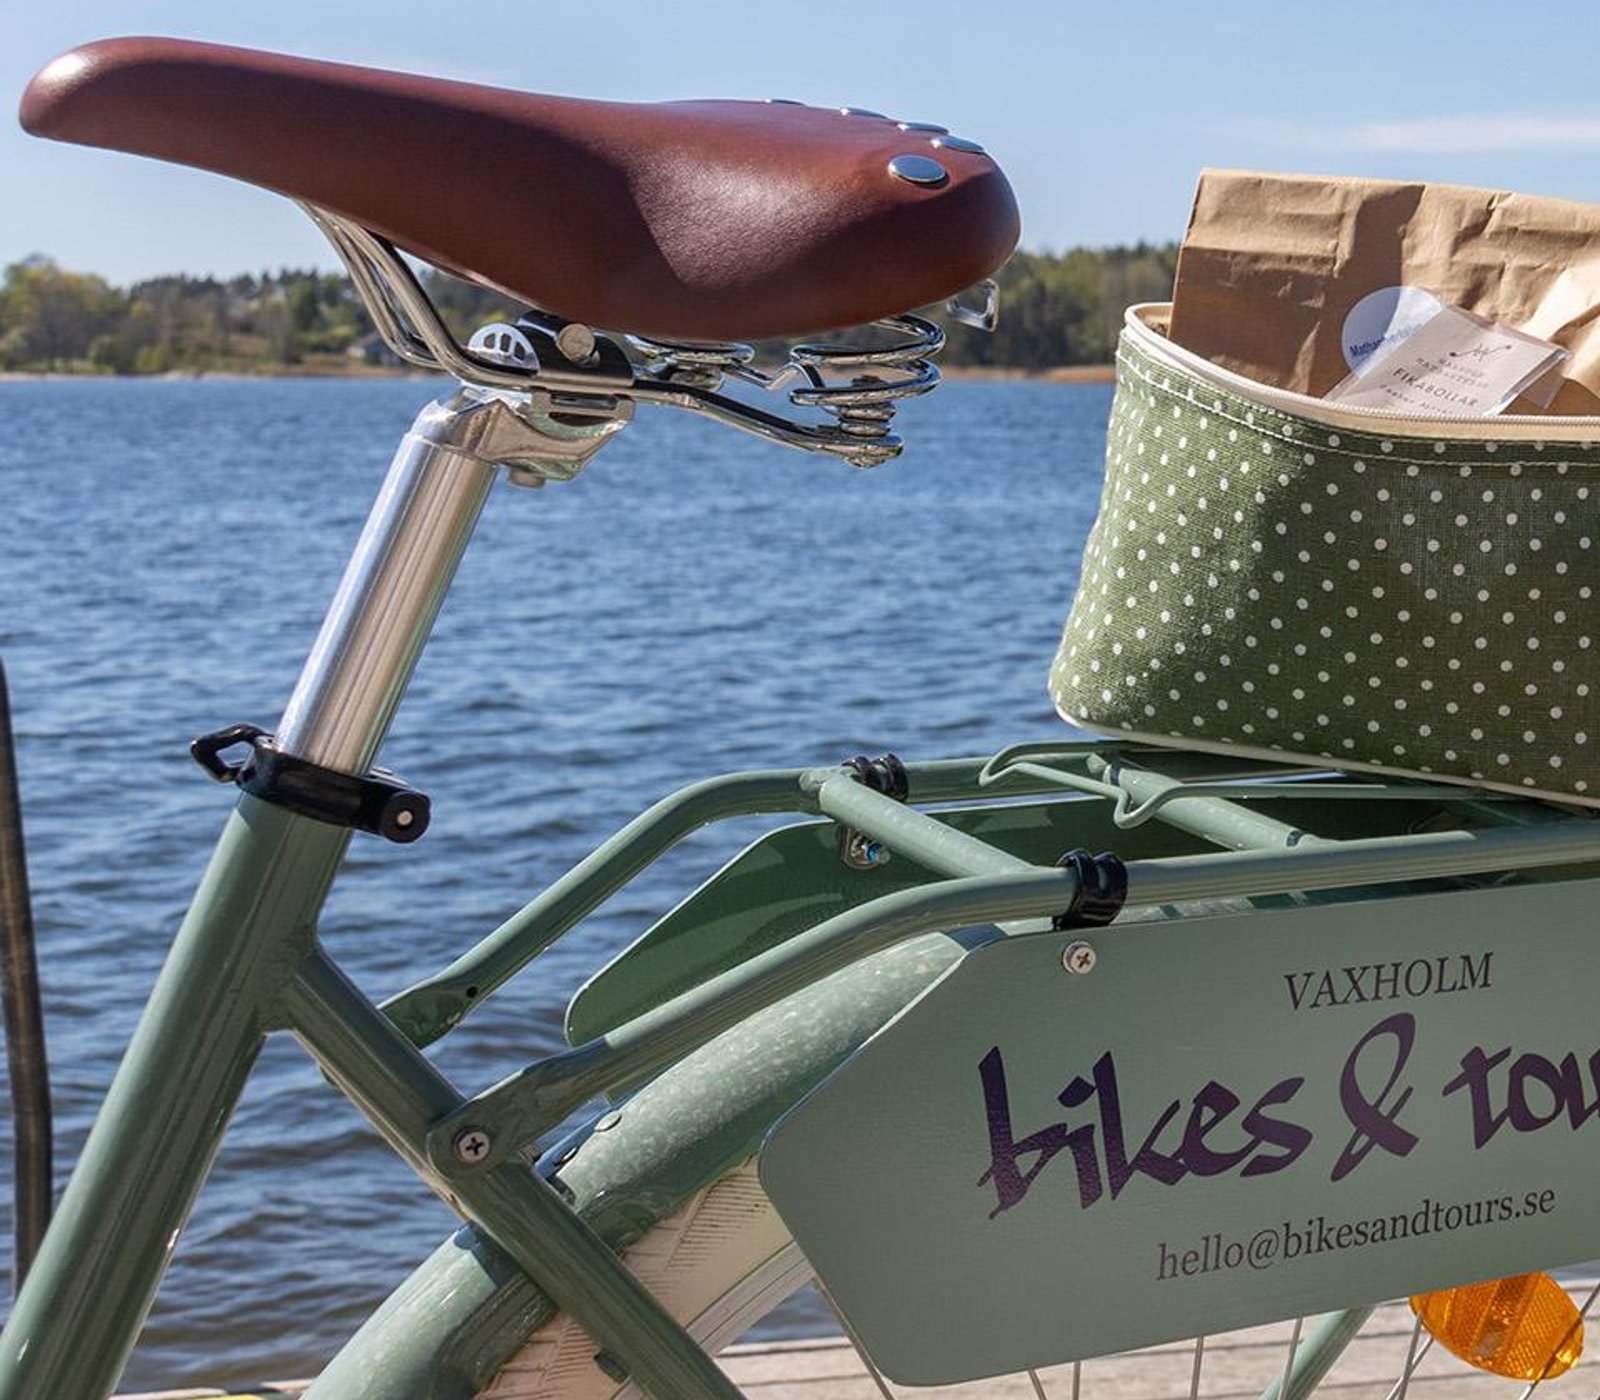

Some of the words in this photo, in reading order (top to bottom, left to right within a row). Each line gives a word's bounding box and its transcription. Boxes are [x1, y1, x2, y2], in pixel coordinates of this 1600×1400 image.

[1393, 367, 1478, 406] FIKABOLLAR
[1284, 951, 1494, 1010] VAXHOLM
[976, 1045, 1313, 1220] bikes
[1330, 1012, 1420, 1182] &
[1156, 1188, 1556, 1281] hello@bikesandtours.se
